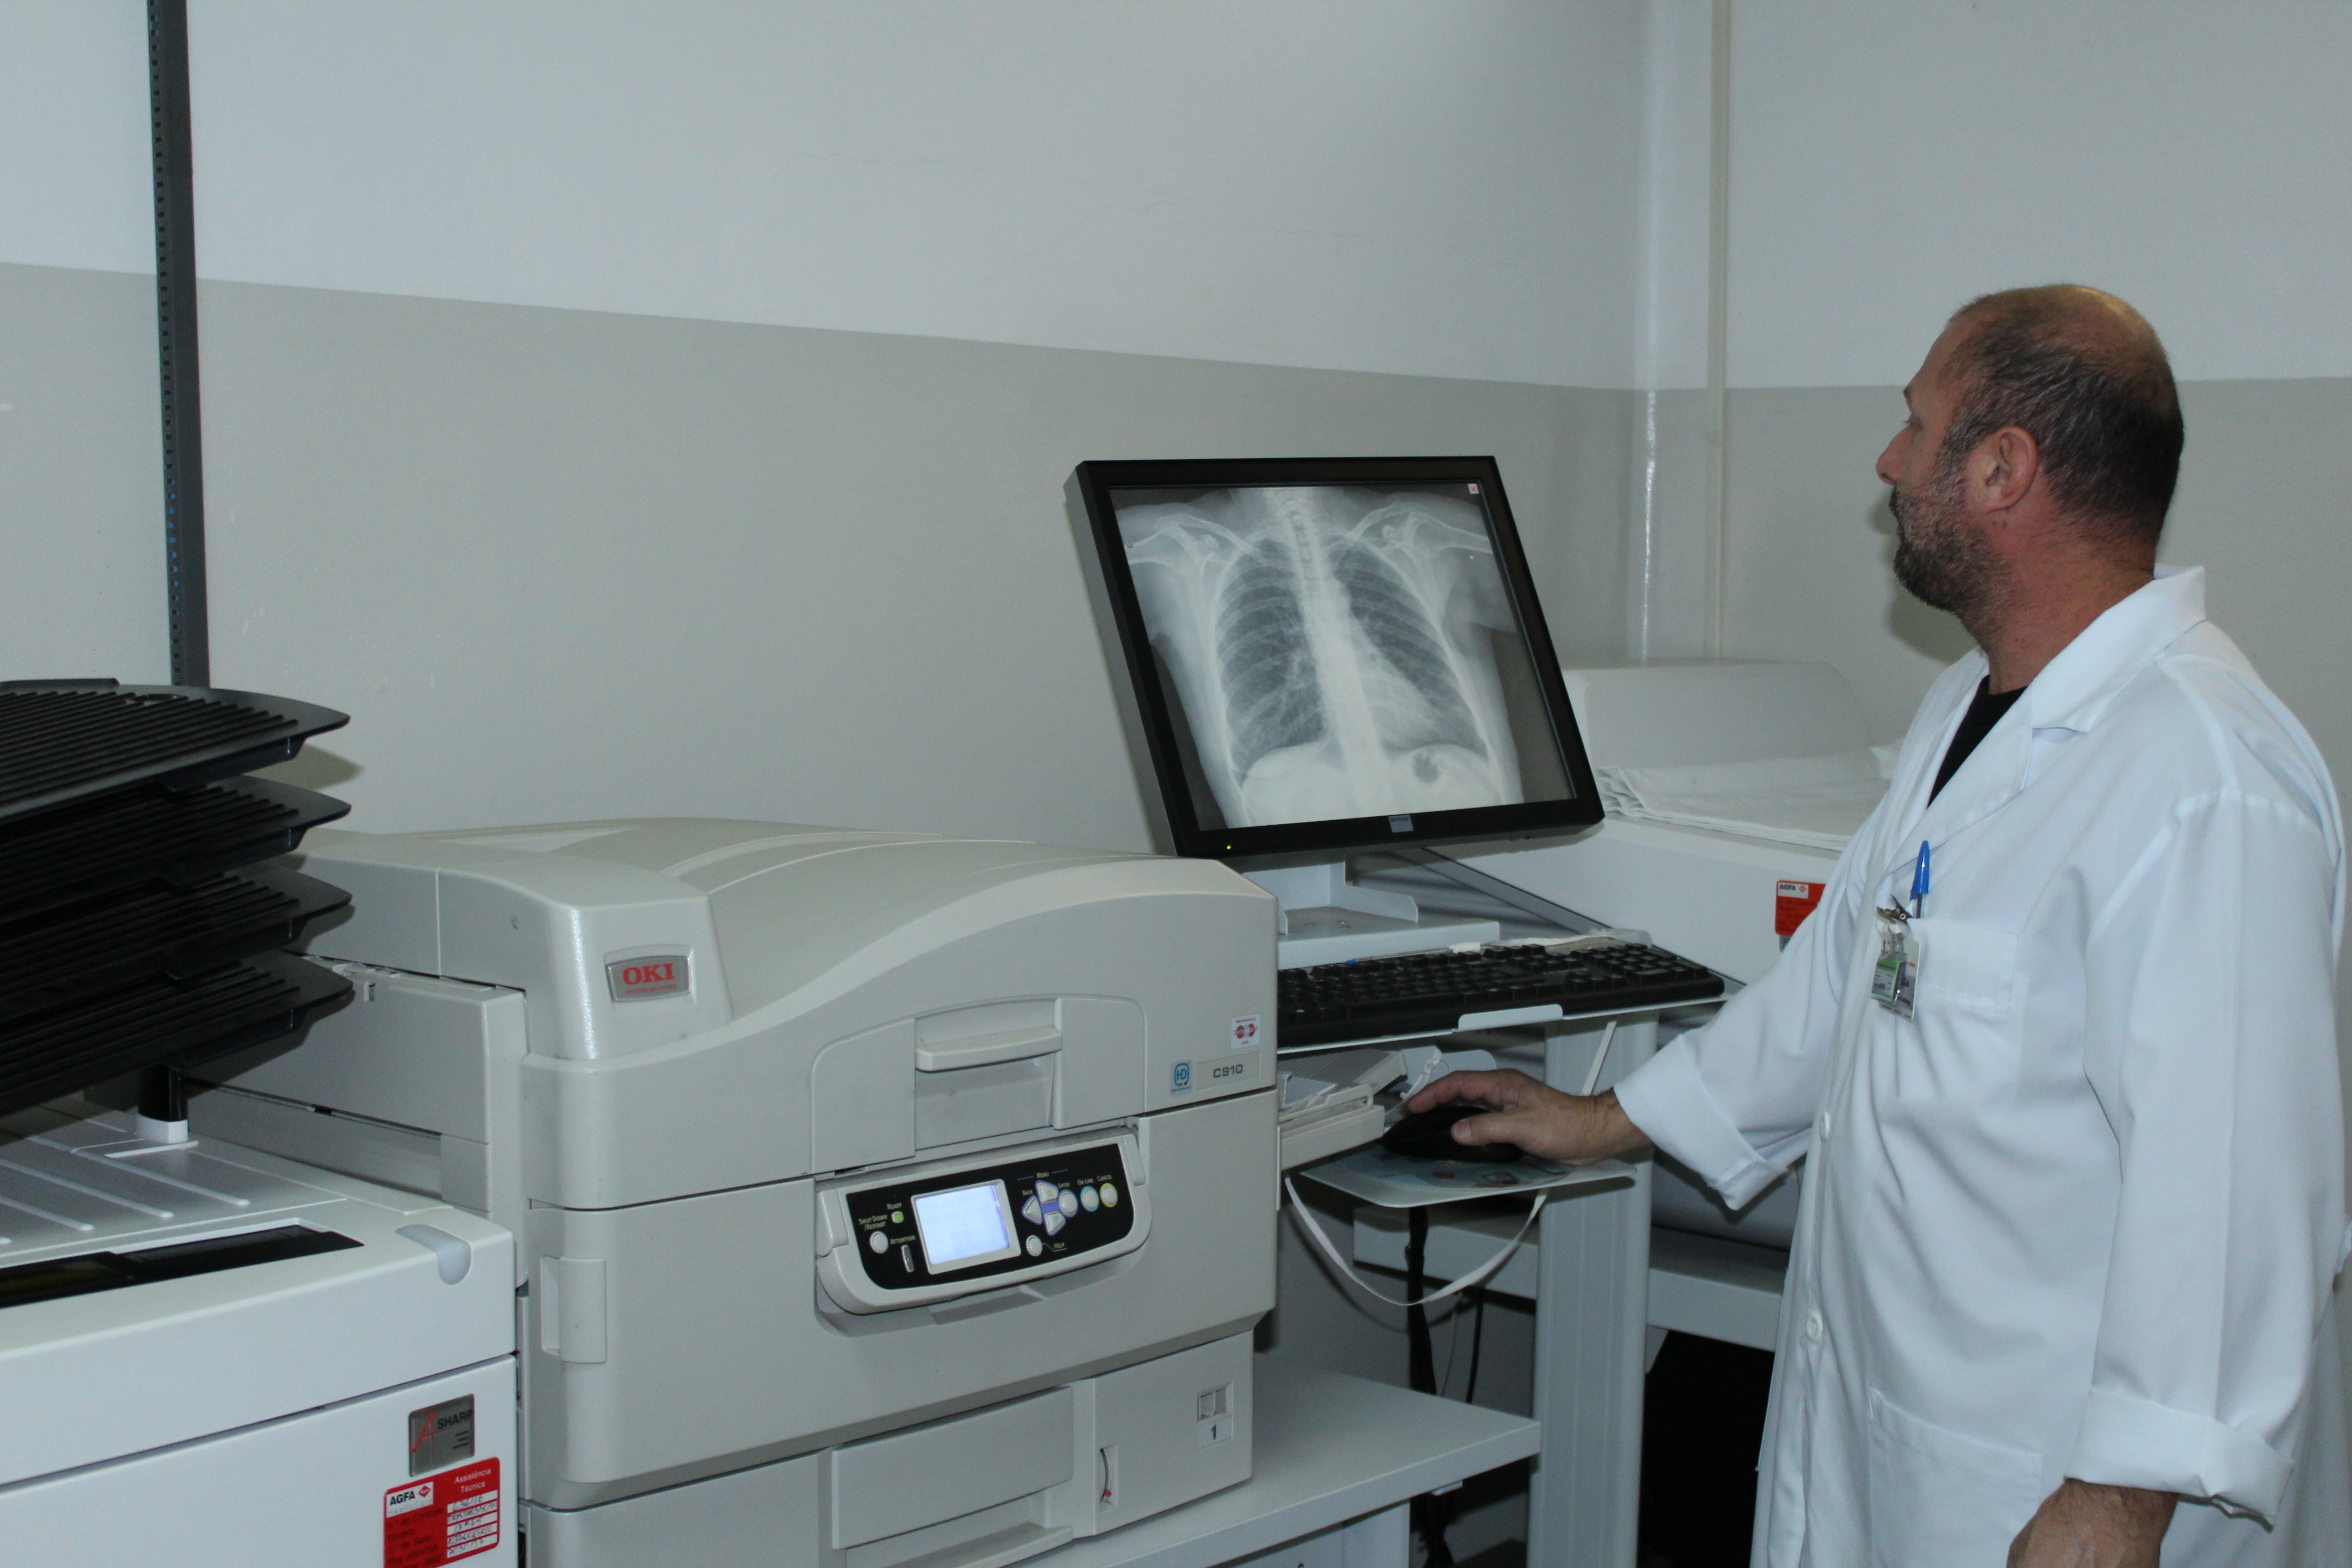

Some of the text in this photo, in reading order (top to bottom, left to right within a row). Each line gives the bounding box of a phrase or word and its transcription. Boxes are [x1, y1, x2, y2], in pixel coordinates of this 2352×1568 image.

[623, 963, 675, 985] OKI
[1176, 1068, 1187, 1081] HD
[1212, 1064, 1243, 1078] C910
[437, 1409, 473, 1430] SHARP
[1211, 1424, 1217, 1441] 1
[390, 1490, 415, 1505] AGFA
